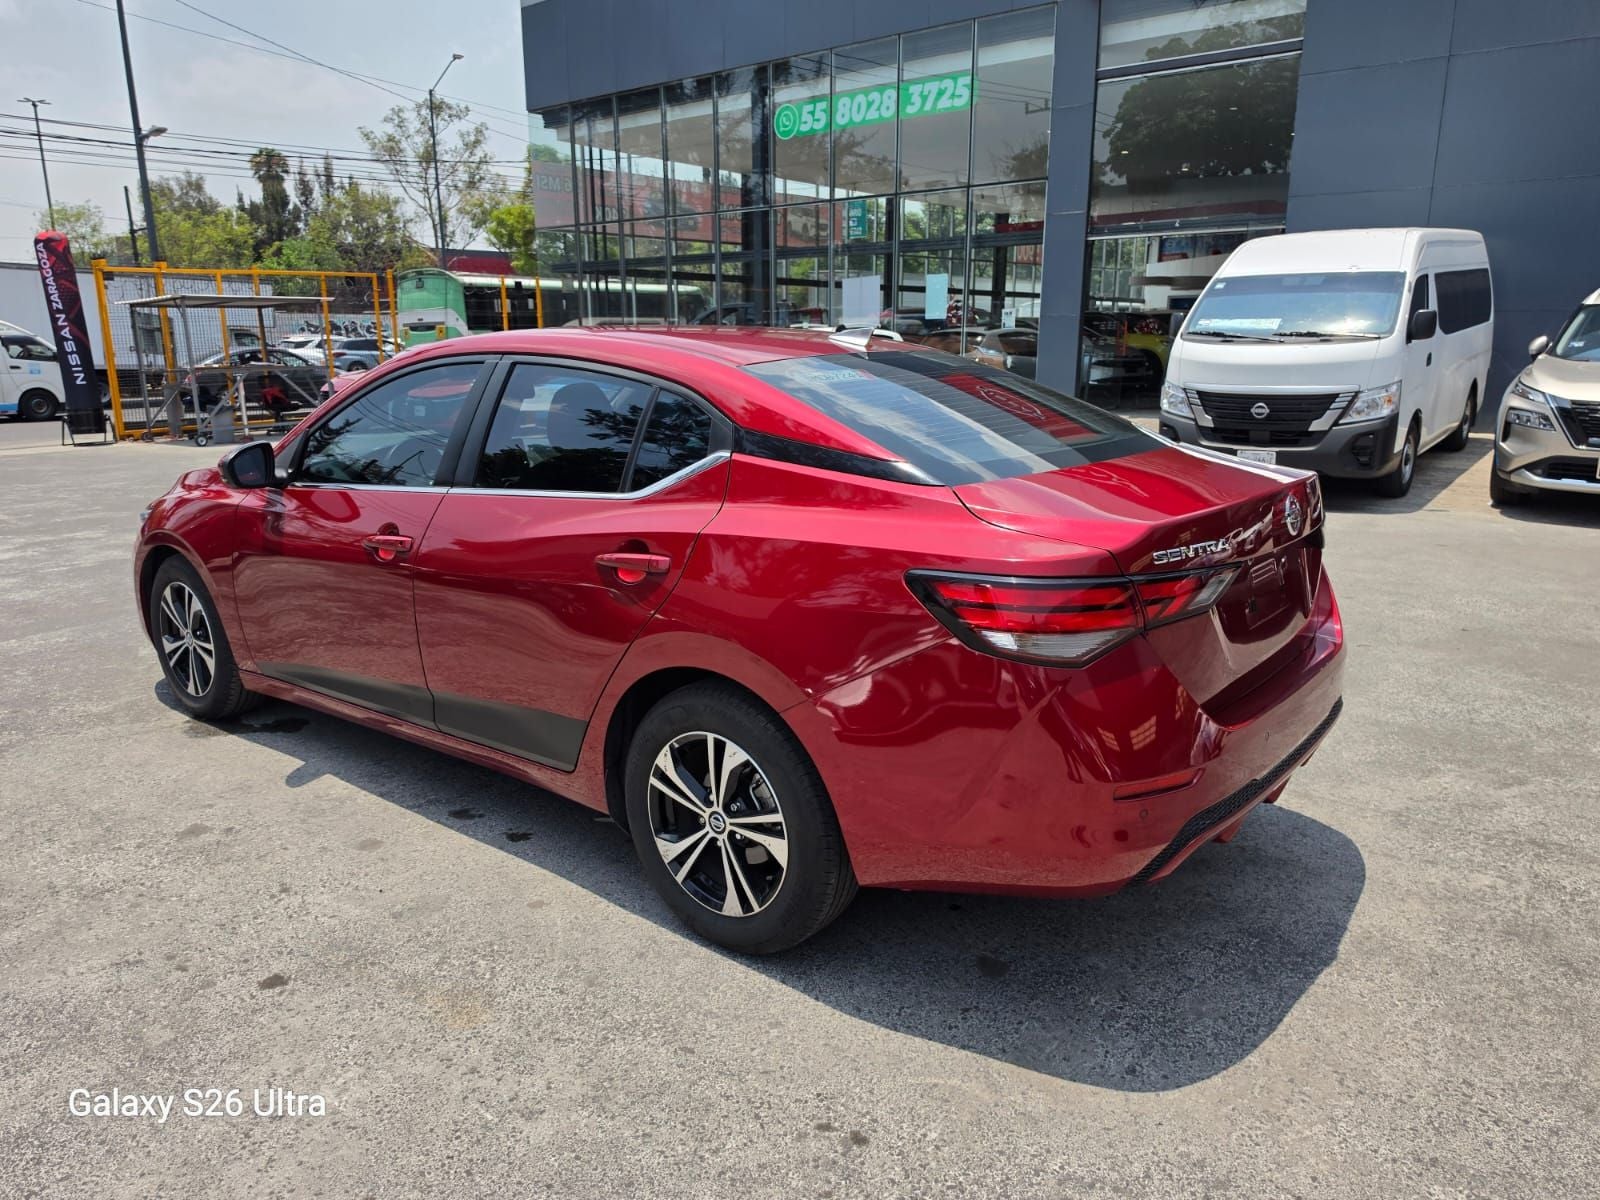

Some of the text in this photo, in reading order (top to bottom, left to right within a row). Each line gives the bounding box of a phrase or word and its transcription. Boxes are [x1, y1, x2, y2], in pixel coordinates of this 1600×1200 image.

[800, 75, 972, 132] 55 8028 3725
[36, 242, 87, 385] NISSAN ZARAGOZA
[1152, 537, 1232, 565] SENTRA
